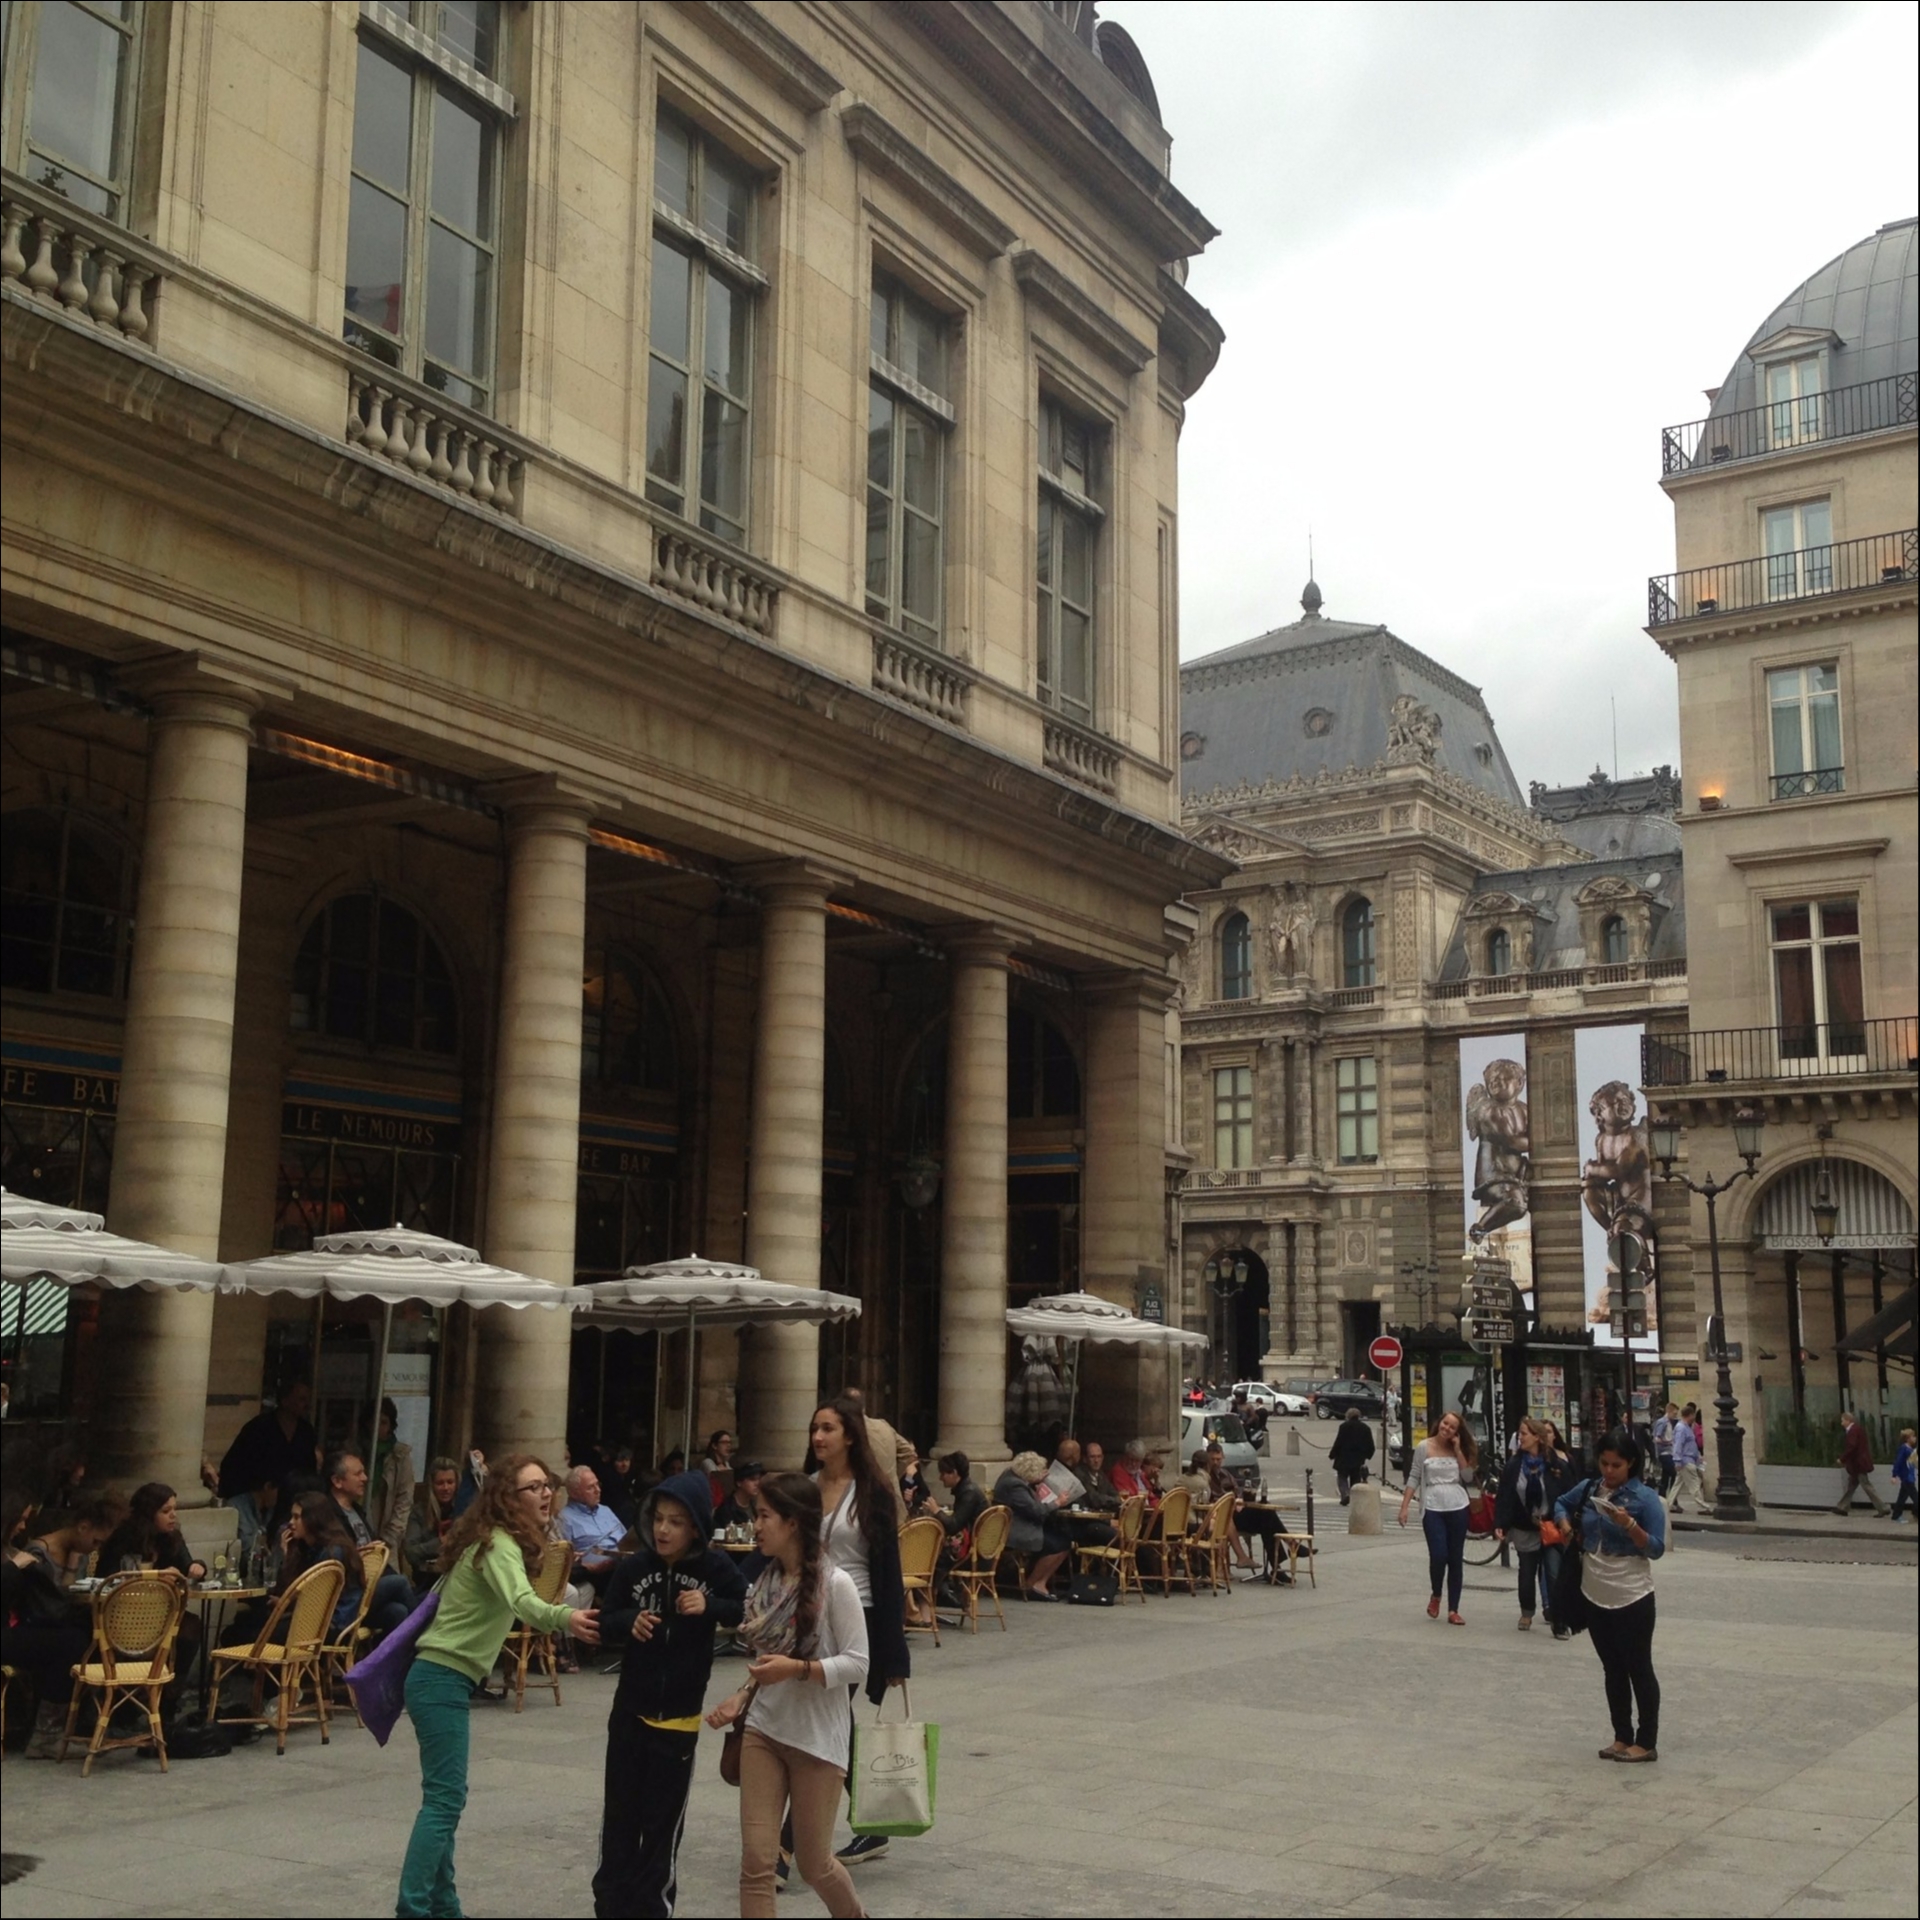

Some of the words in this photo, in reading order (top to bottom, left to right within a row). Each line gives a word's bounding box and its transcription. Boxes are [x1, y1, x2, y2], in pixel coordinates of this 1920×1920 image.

[296, 1108, 323, 1132] LE
[340, 1114, 436, 1146] NEMOURS
[619, 1152, 652, 1174] BAR
[1771, 1235, 1834, 1248] Brassere
[1838, 1235, 1855, 1248] du
[1858, 1234, 1909, 1247] Louvre
